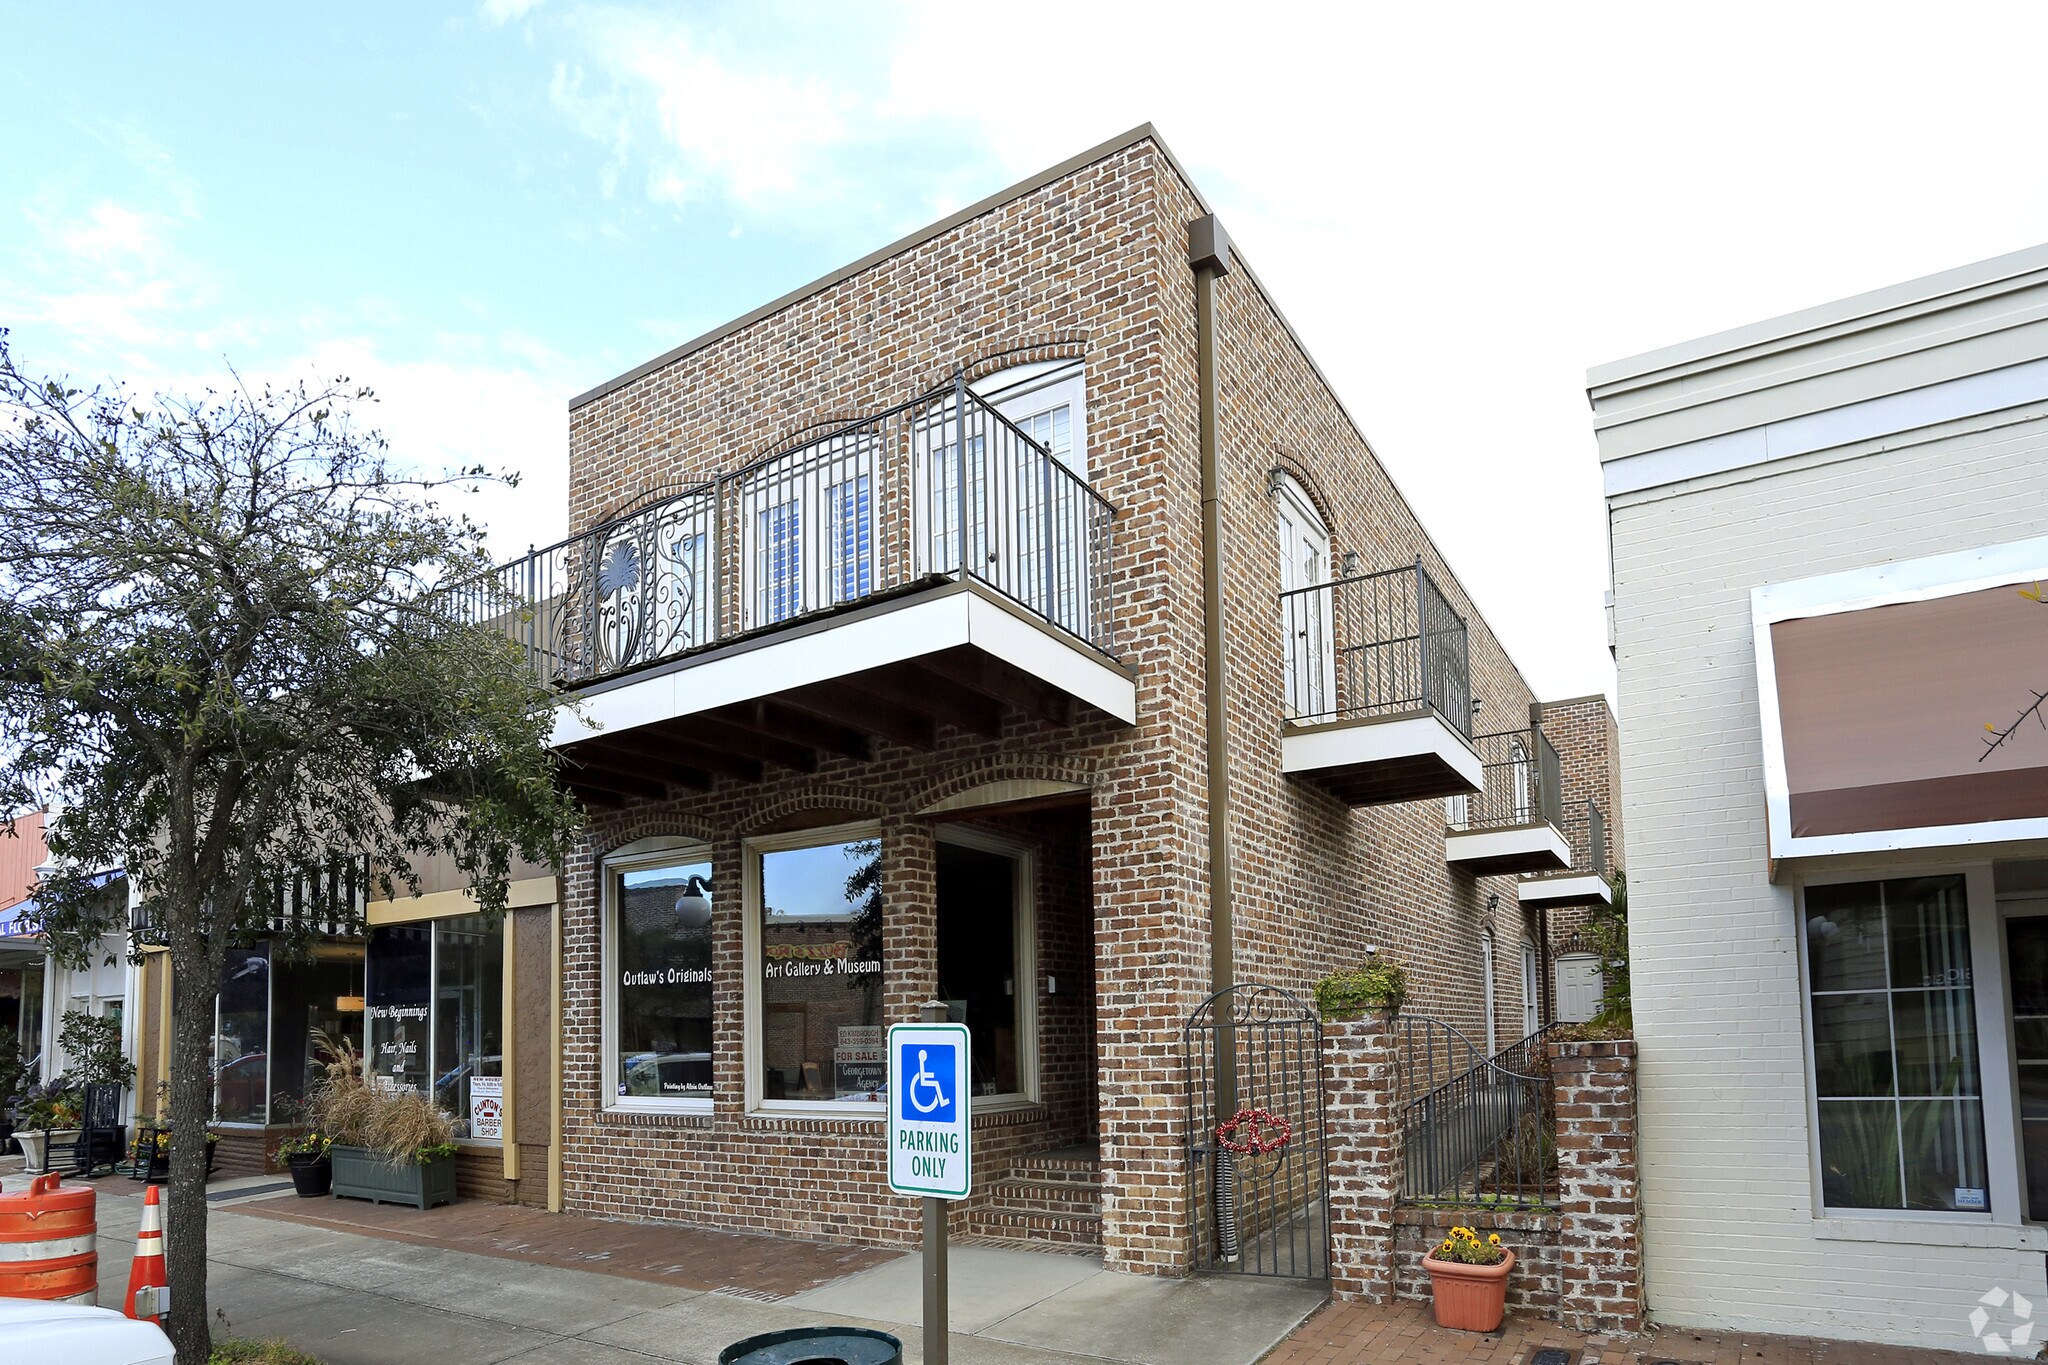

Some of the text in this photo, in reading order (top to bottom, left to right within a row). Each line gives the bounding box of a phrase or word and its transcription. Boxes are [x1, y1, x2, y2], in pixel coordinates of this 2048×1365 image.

[623, 967, 712, 986] Outlaw's Originals
[765, 957, 881, 978] Art Gallery & Museum
[370, 1003, 428, 1022] New Beginnings
[380, 1040, 417, 1056] Hair, Nails
[836, 1051, 852, 1061] FOR
[855, 1051, 878, 1061] SALE
[392, 1059, 406, 1073] and
[474, 1099, 502, 1118] CLINTON'S
[476, 1117, 502, 1128] BARBER
[480, 1127, 498, 1137] SHOP
[899, 1129, 959, 1154] PARKING
[911, 1155, 946, 1179] ONLY
